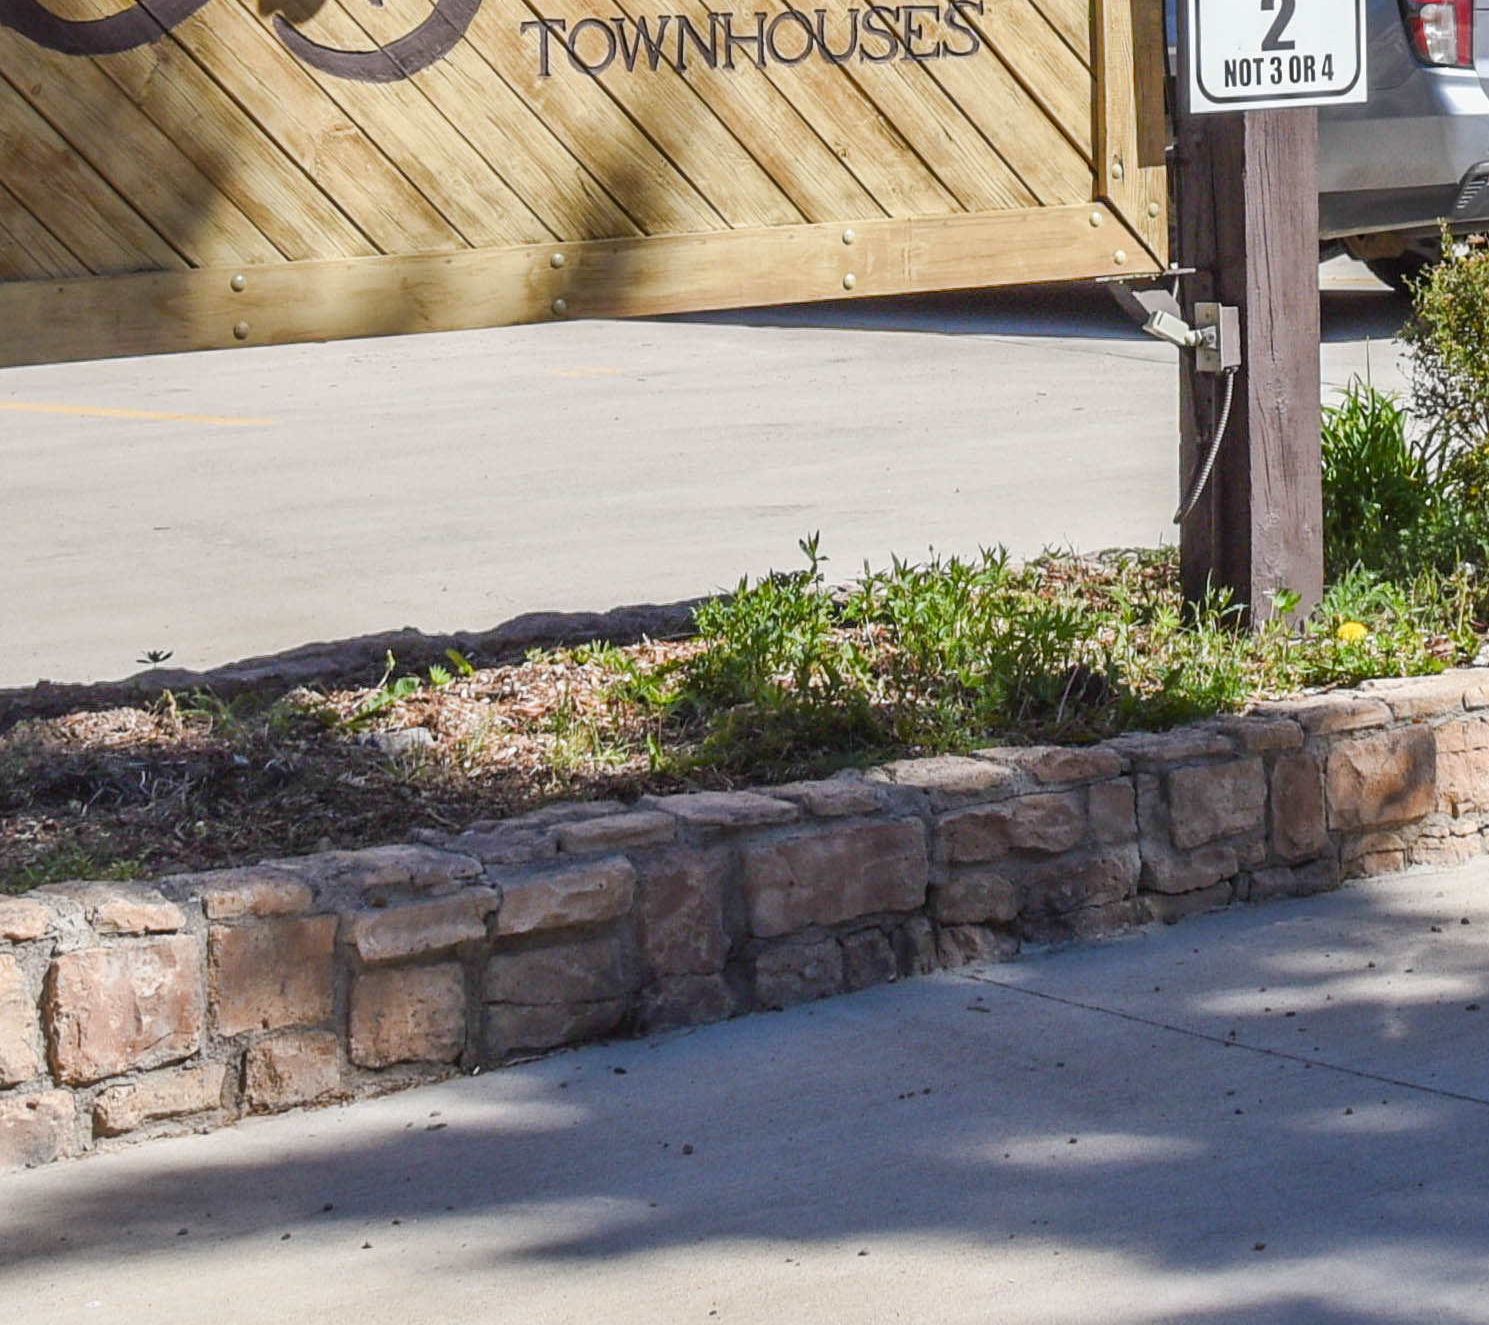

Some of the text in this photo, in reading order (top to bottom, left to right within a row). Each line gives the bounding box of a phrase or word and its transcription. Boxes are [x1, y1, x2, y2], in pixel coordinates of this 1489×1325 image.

[521, 0, 985, 78] TOWNHOUSES
[1224, 53, 1334, 88] NOT 3 OR 4
